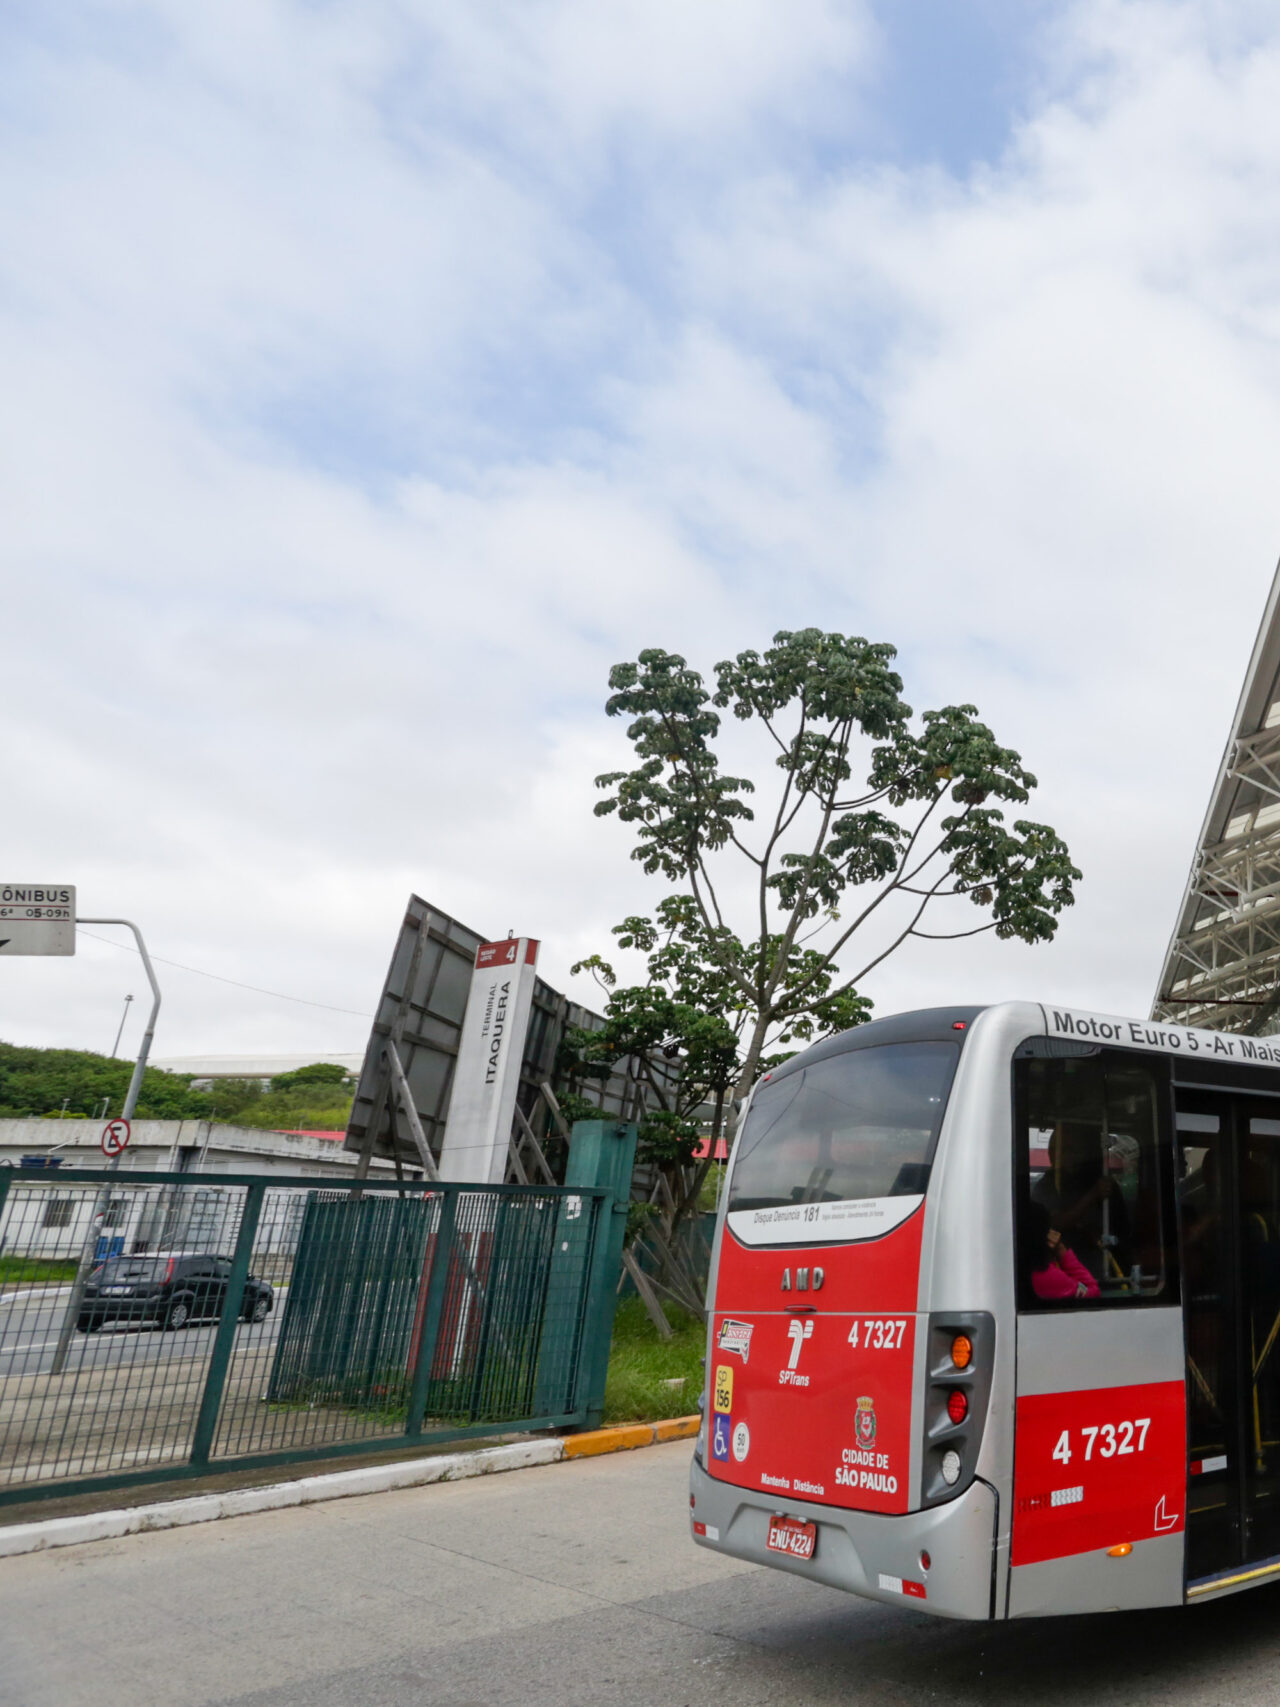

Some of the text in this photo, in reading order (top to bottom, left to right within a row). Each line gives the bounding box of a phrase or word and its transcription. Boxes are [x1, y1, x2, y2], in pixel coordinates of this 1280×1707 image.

[2, 886, 70, 902] ÔNIBUS
[26, 908, 70, 918] 05-09h
[506, 945, 515, 961] 4
[482, 983, 497, 1038] TERMINAL
[485, 981, 511, 1084] ITAQUERA
[1053, 1011, 1122, 1042] Motor
[1128, 1022, 1181, 1049] Euro
[1187, 1033, 1199, 1050] 5
[754, 1211, 772, 1225] Disque
[804, 1206, 820, 1222] 181
[848, 1320, 907, 1349] 4 7327
[718, 1370, 728, 1387] SP
[779, 1370, 810, 1387] SPTrans
[717, 1389, 730, 1408] 156
[1052, 1418, 1151, 1464] 4 7327
[842, 1449, 889, 1469] CIDADE DE
[761, 1473, 824, 1495] Mantenha Distância
[835, 1465, 897, 1494] SÃO PAULO
[769, 1528, 812, 1555] ENU-4224
